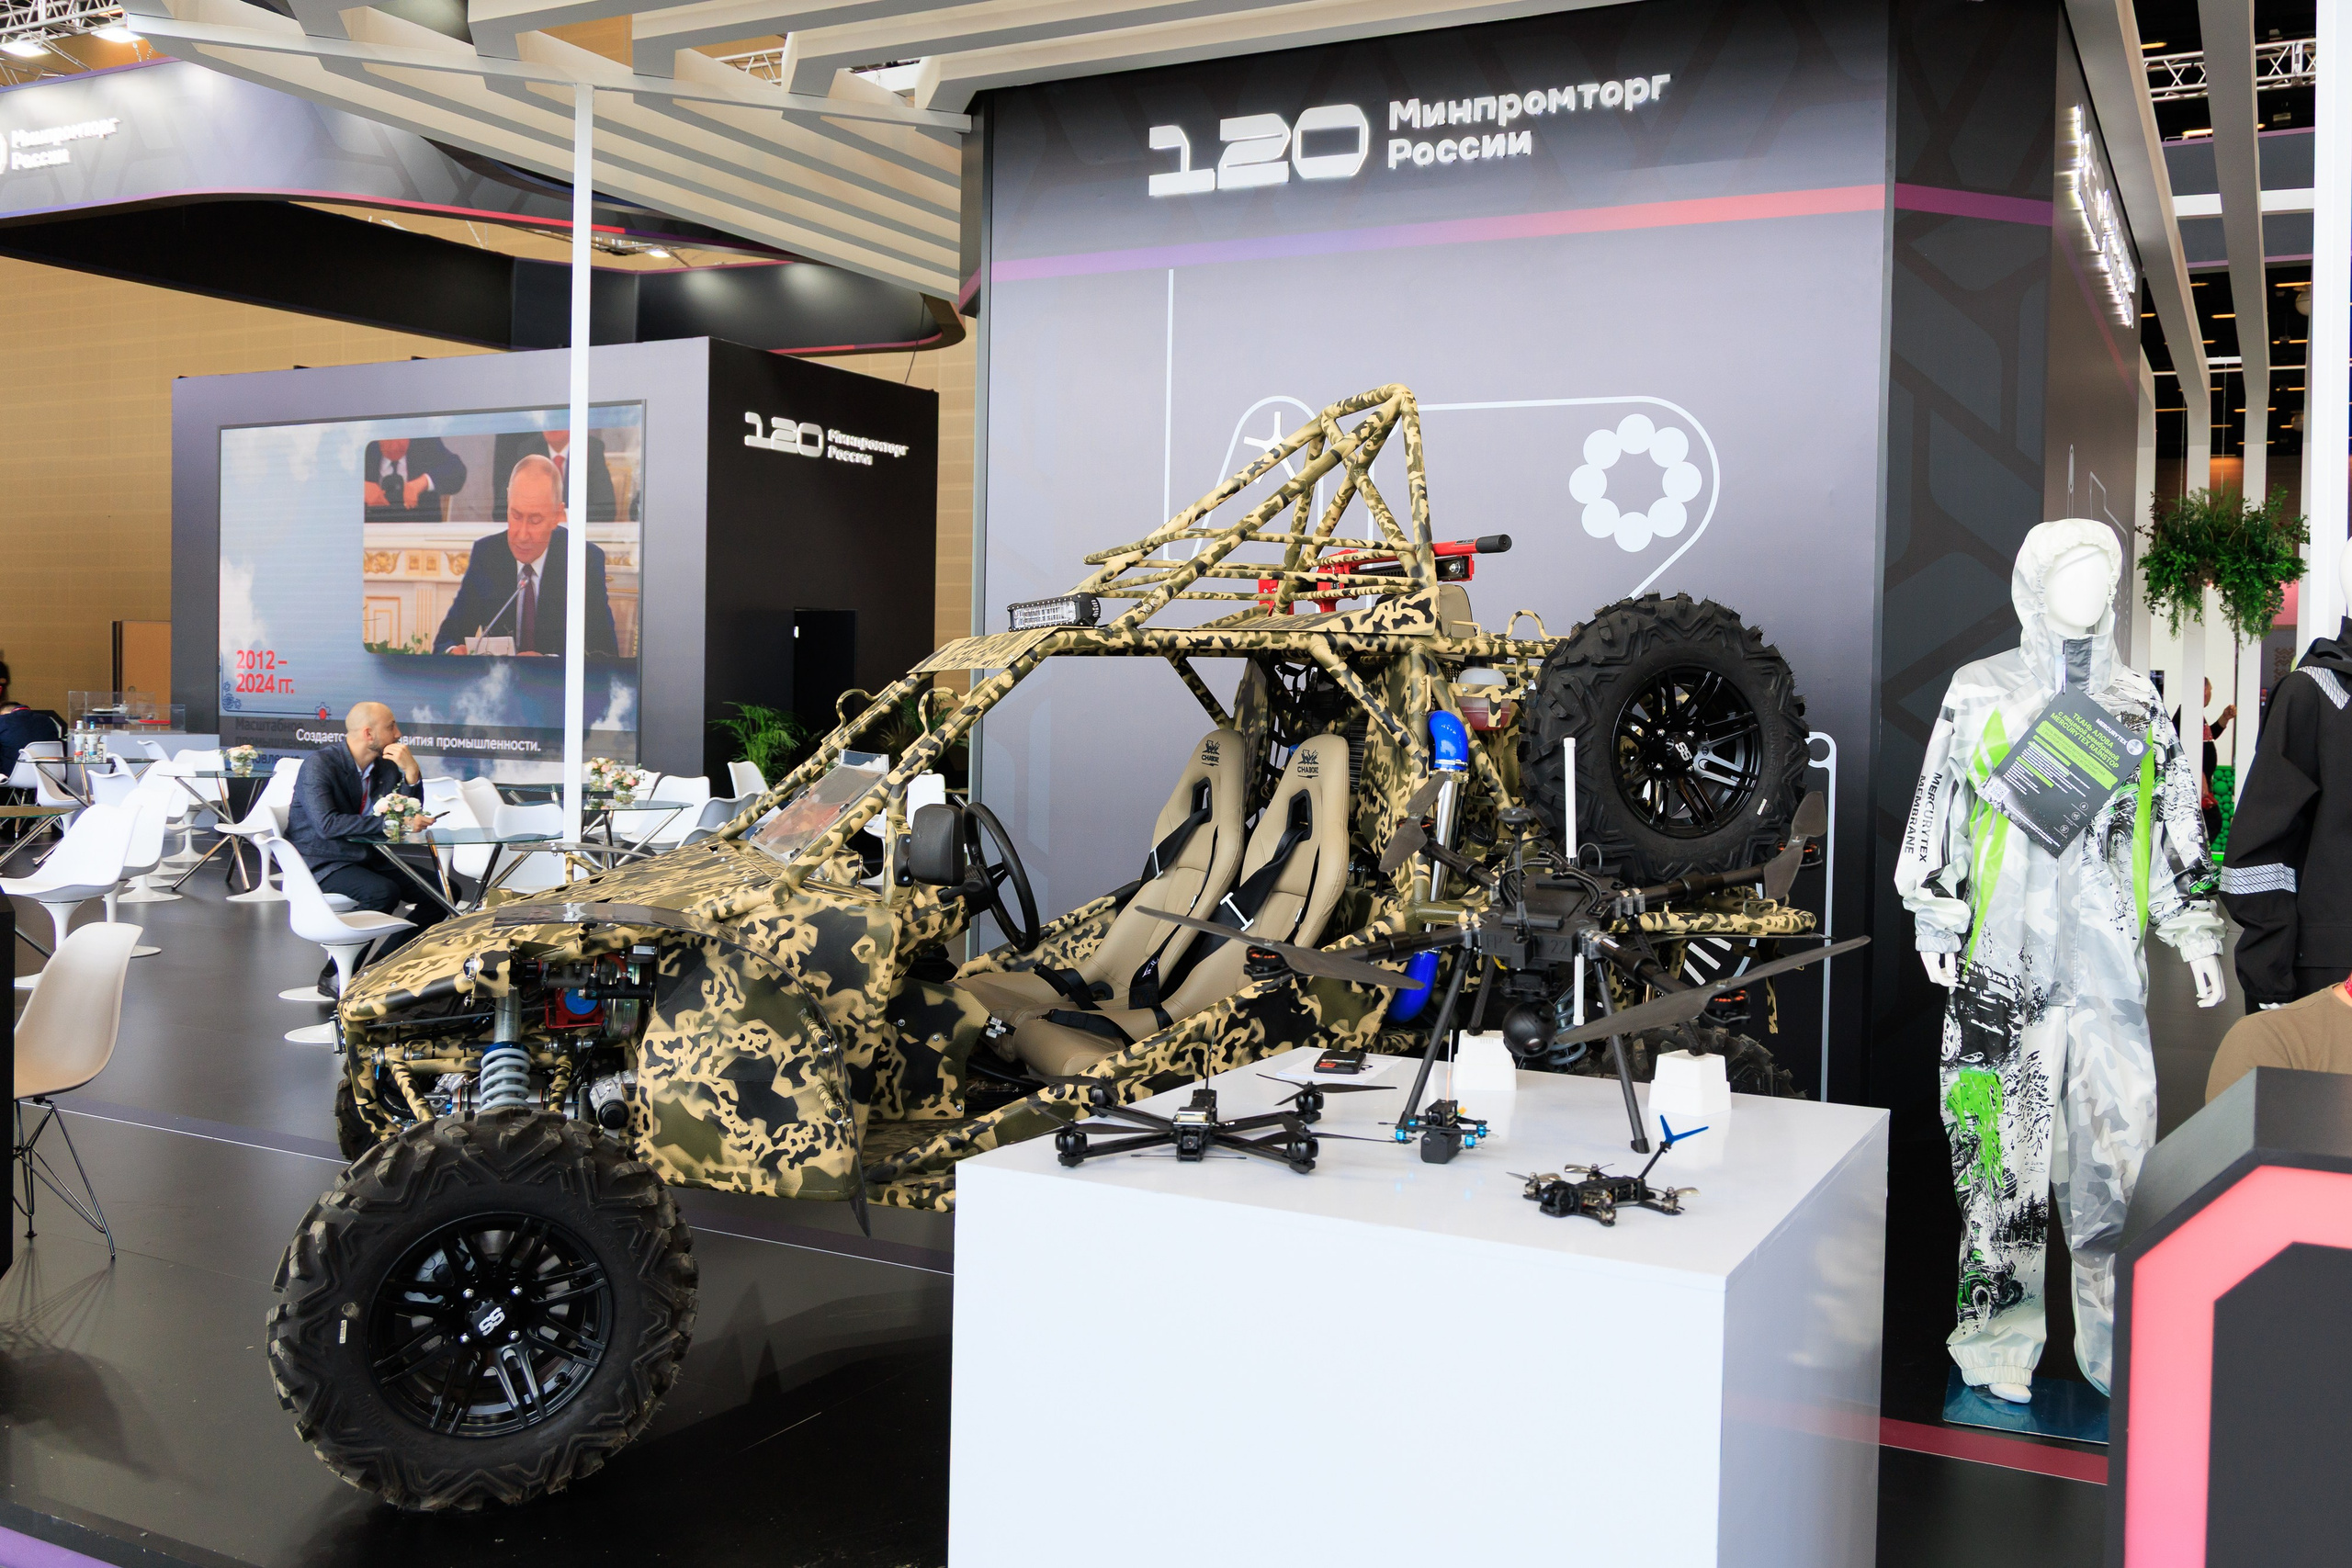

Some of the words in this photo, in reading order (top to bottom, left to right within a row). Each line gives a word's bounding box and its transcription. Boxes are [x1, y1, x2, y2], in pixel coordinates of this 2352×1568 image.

[1389, 74, 1670, 130] Минпромторг
[11, 149, 70, 170] России
[1148, 104, 1369, 196] 120
[1387, 130, 1532, 169] России
[744, 412, 824, 457] 120
[828, 429, 909, 457] Минпромторг
[827, 446, 873, 466] России
[236, 650, 275, 670] 2012
[236, 673, 275, 694] 2024
[296, 728, 347, 744] Создаетс
[436, 737, 541, 751] промышленности.
[2050, 712, 2090, 746] MERCURYTEX
[2088, 743, 2120, 769] RAINSTOP
[2062, 714, 2088, 738] лицевой
[2086, 733, 2120, 761] мембраной
[2073, 713, 2093, 731] ТКАНЬ
[2092, 728, 2114, 749] АЛОВА
[2096, 718, 2128, 746] MERCURYTEX
[1905, 775, 1926, 854] MEMBRANE
[1919, 772, 1943, 863] MERCURYTEX
[479, 1306, 505, 1336] SS
